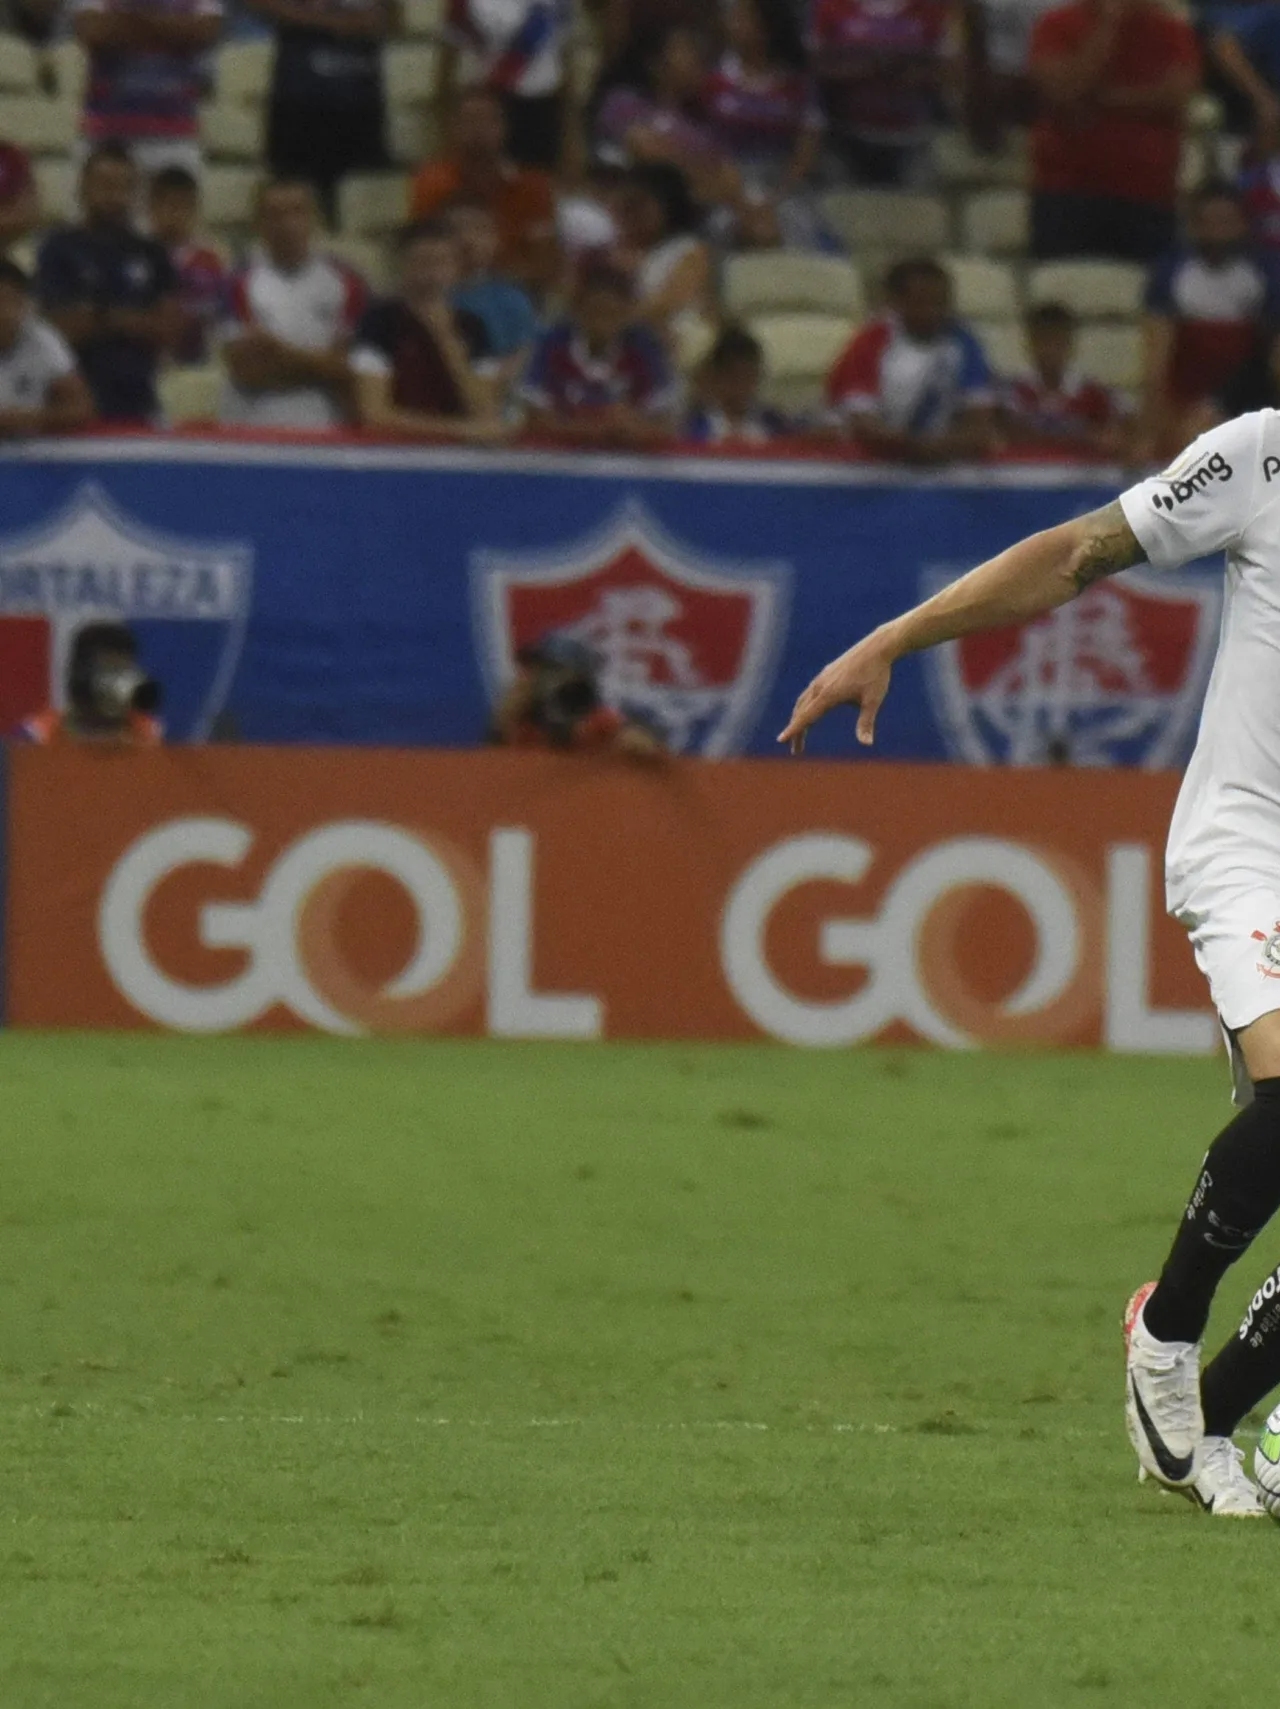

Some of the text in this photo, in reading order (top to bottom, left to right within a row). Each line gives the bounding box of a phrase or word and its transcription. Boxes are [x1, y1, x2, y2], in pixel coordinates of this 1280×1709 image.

[1169, 452, 1233, 505] bmg
[0, 563, 221, 607] ORTALEZA
[97, 814, 604, 1038] GOL
[720, 831, 1218, 1054] GOL
